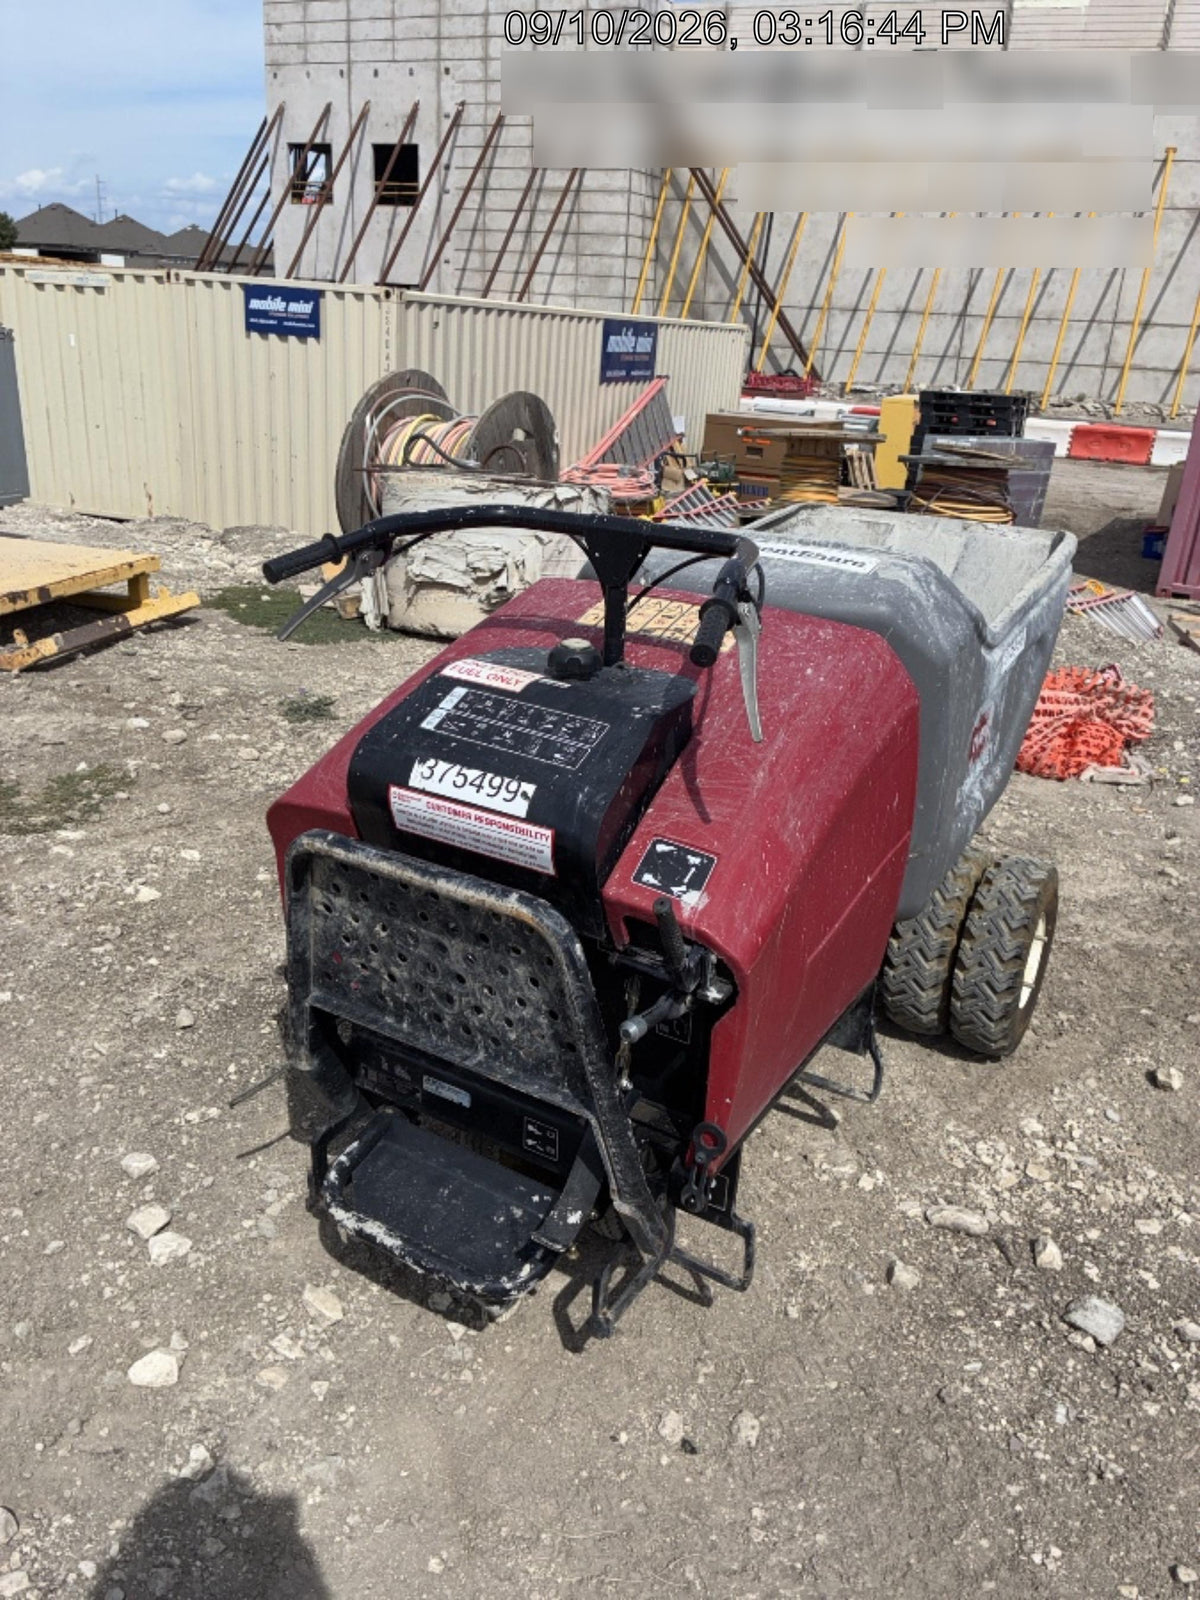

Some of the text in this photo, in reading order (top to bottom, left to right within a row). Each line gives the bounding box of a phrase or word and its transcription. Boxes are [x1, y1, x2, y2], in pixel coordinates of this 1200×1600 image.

[248, 295, 287, 312] mobile
[449, 664, 483, 678] FUEL
[486, 672, 524, 687] ONLY
[420, 758, 522, 802] 375499
